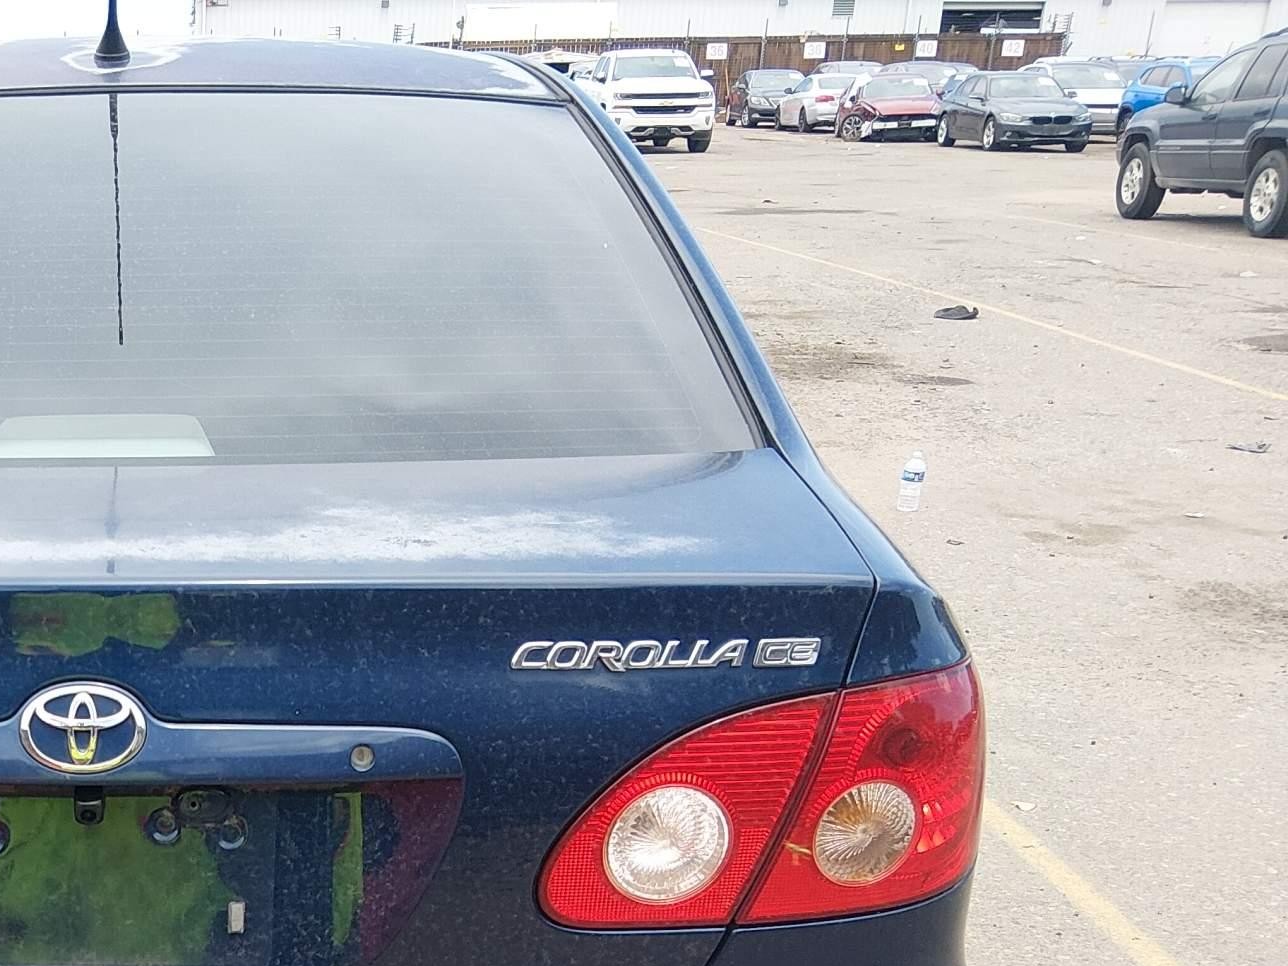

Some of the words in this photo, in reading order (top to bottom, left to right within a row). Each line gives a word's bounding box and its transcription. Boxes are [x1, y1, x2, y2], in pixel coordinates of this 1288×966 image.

[919, 42, 934, 55] 40
[1005, 41, 1021, 54] 42
[511, 639, 749, 672] COROLLA
[755, 639, 820, 666] CE
